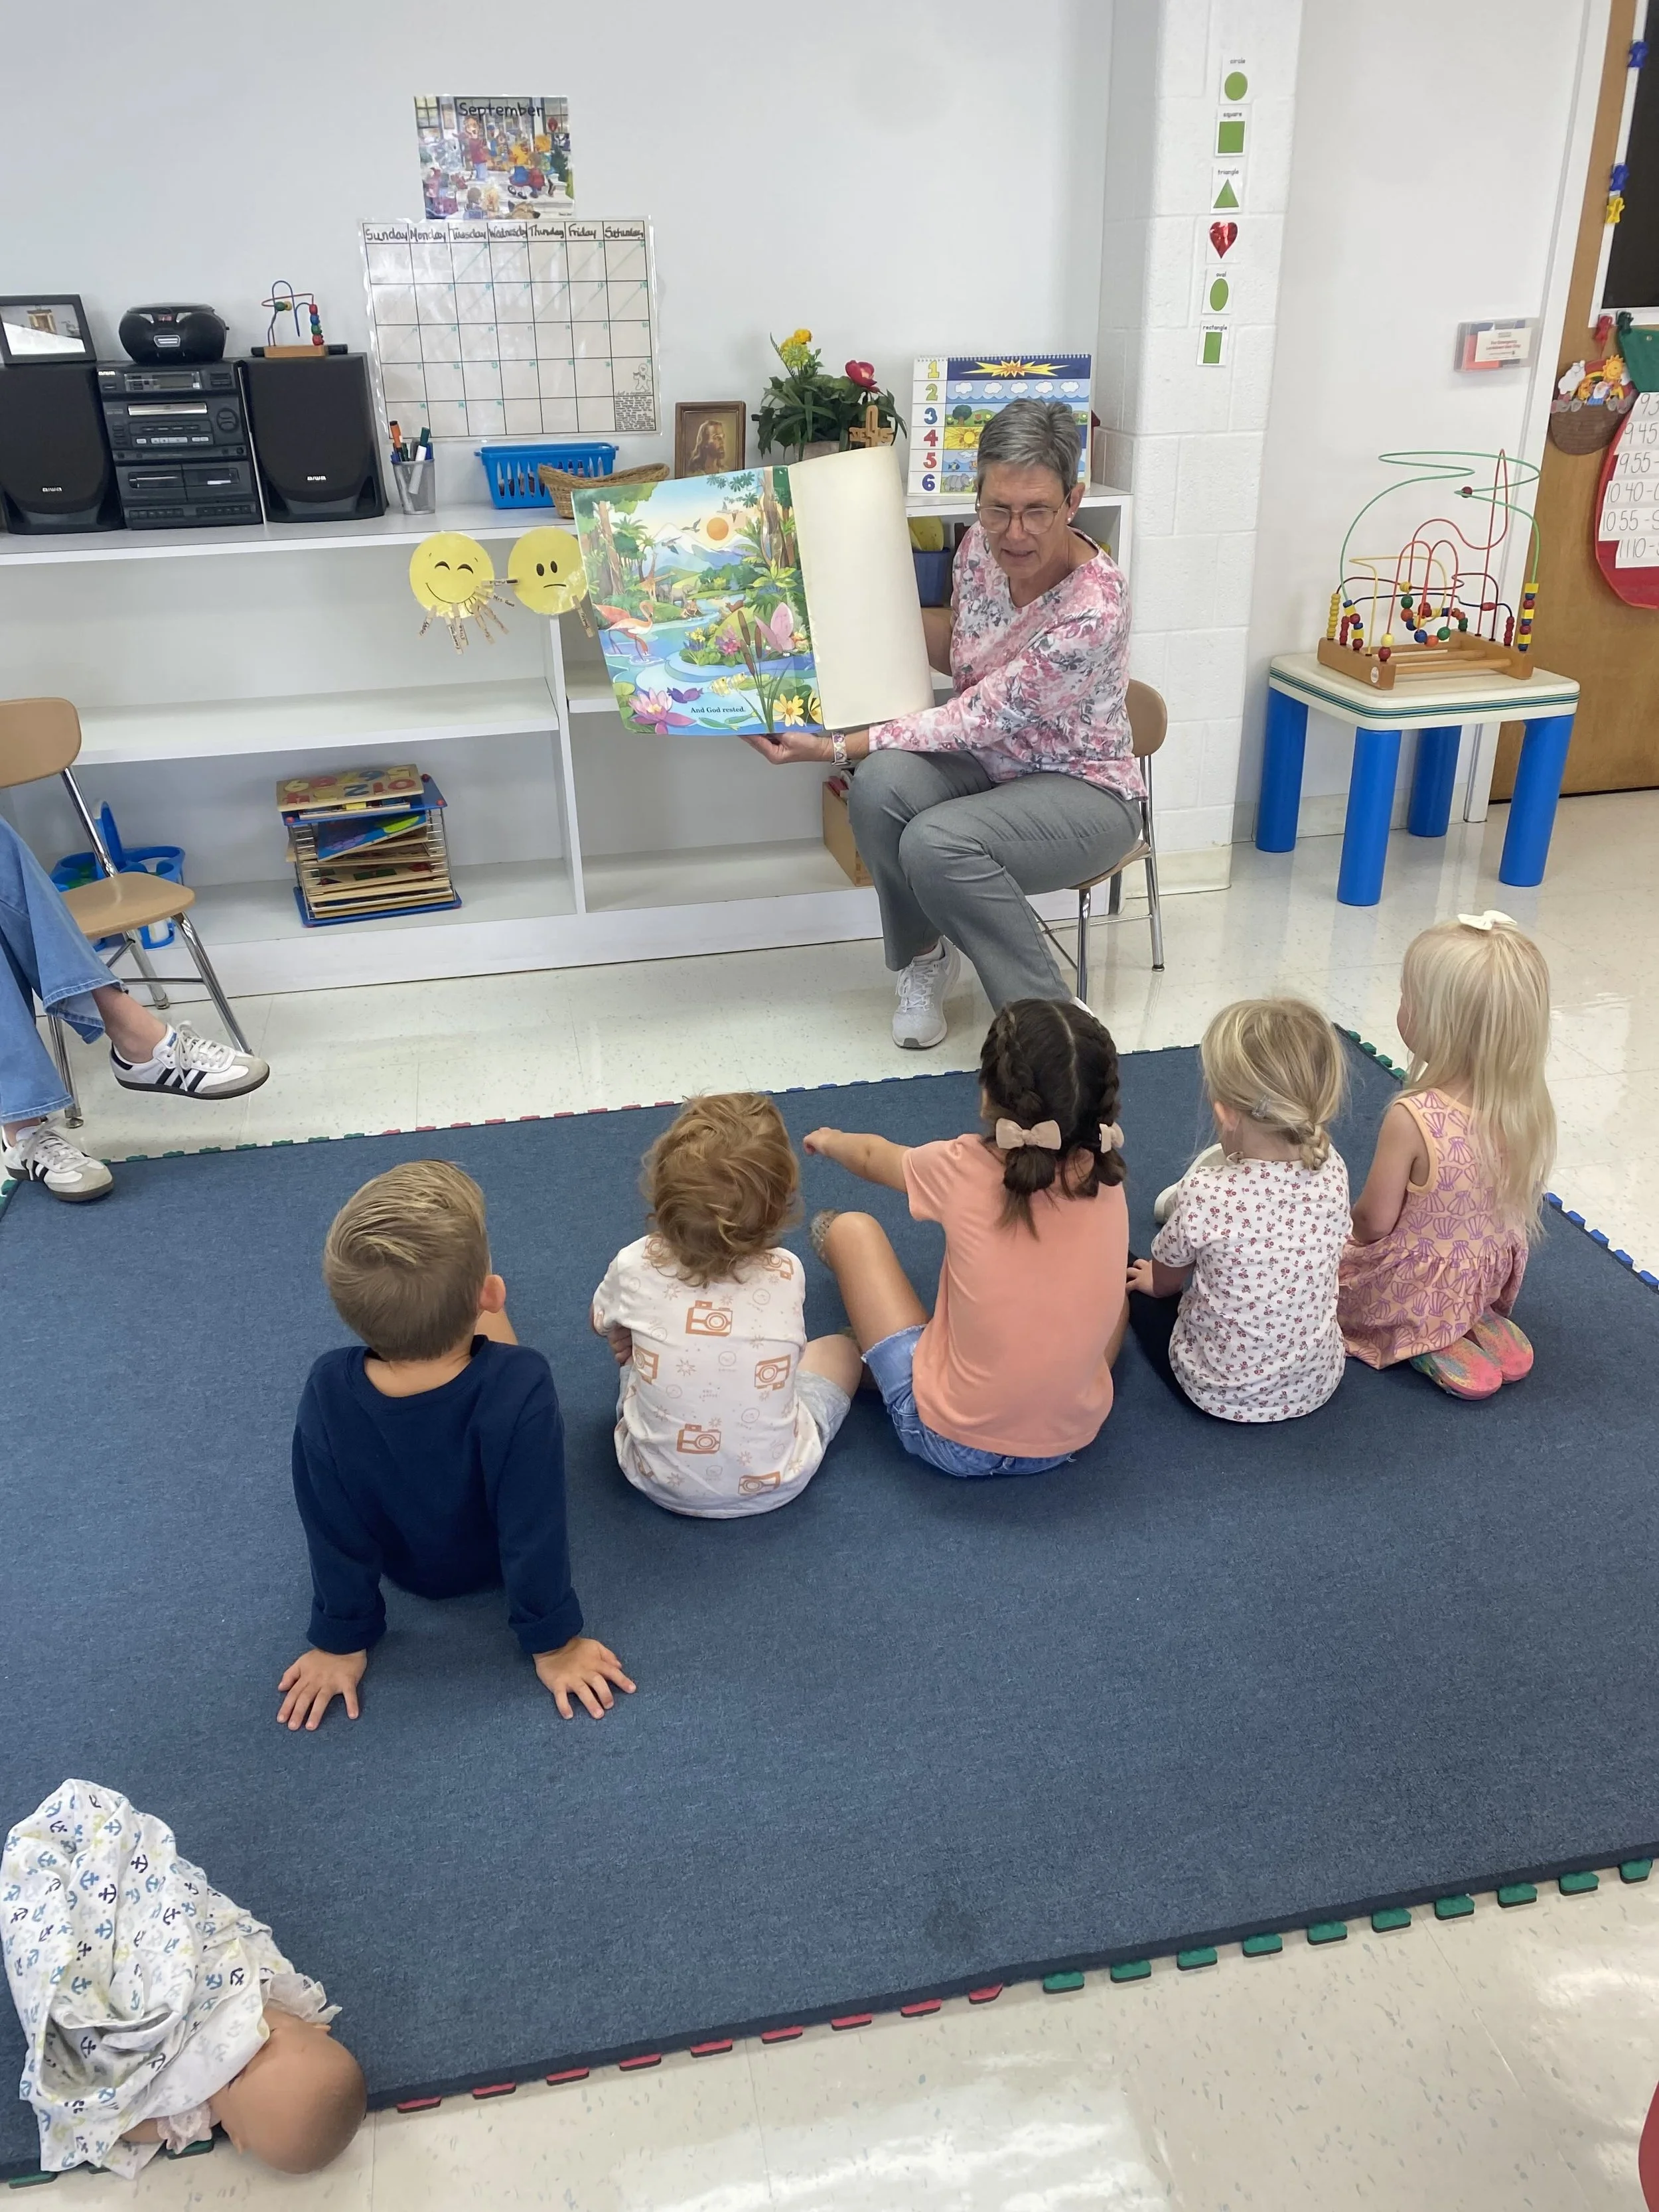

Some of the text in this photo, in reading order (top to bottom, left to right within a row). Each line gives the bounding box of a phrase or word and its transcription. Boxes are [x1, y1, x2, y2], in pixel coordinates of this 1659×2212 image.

[459, 102, 543, 120] September
[366, 227, 407, 241] Sunday
[410, 226, 446, 242] Monday
[449, 227, 486, 240] Tuesday
[528, 224, 564, 239] Thursday
[568, 223, 597, 239] Friday
[928, 360, 940, 378] 1
[925, 384, 938, 401] 2
[924, 407, 937, 424] 3
[924, 429, 938, 447] 4
[923, 452, 936, 469] 5
[922, 474, 935, 491] 6
